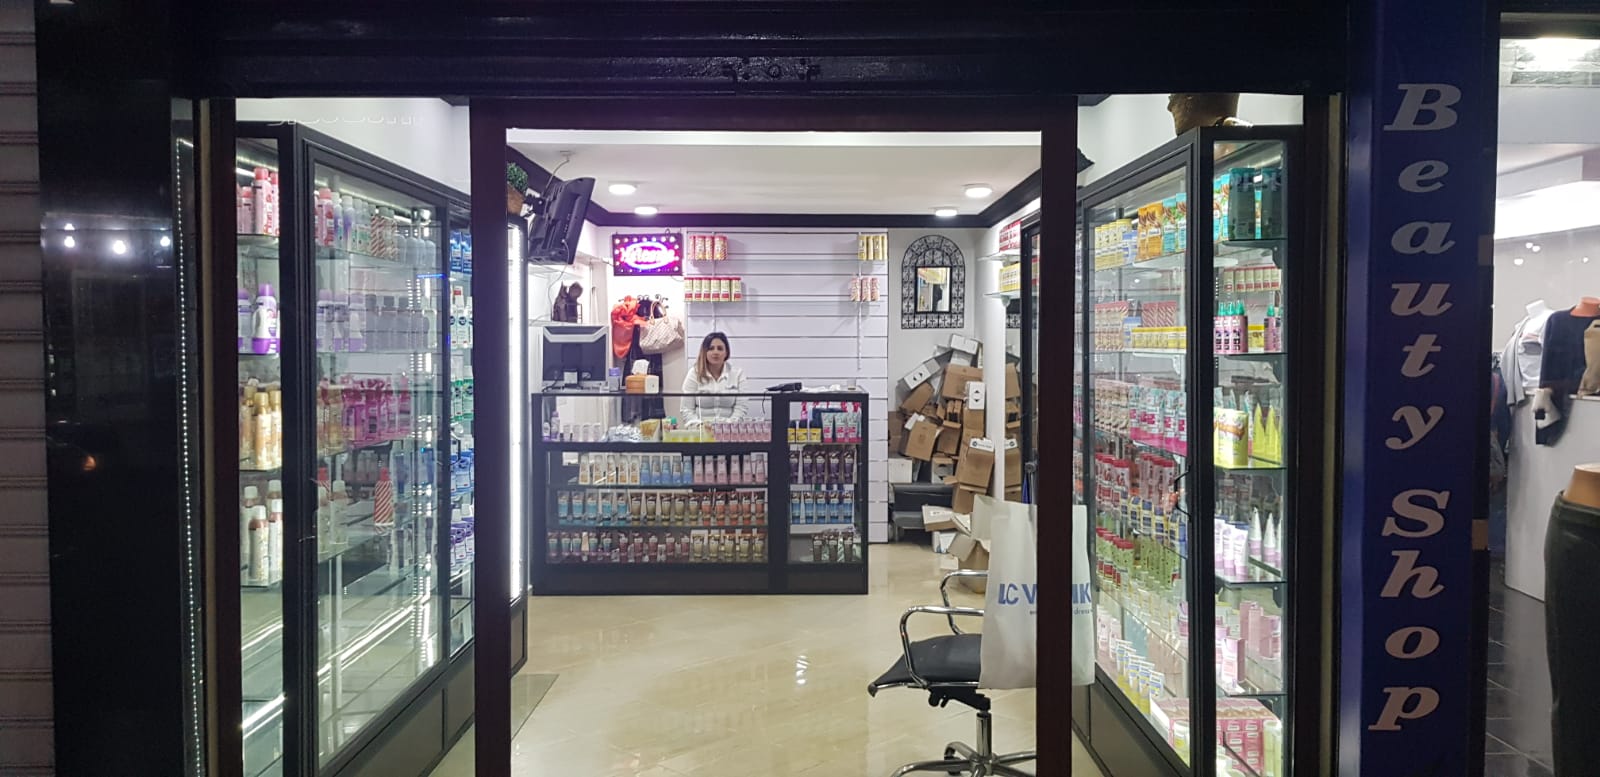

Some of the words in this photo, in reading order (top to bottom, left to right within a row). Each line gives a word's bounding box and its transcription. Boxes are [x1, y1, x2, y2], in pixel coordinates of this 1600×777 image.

[1384, 83, 1461, 450] Beauty
[998, 582, 1019, 605] LC
[1368, 488, 1451, 731] Shop
